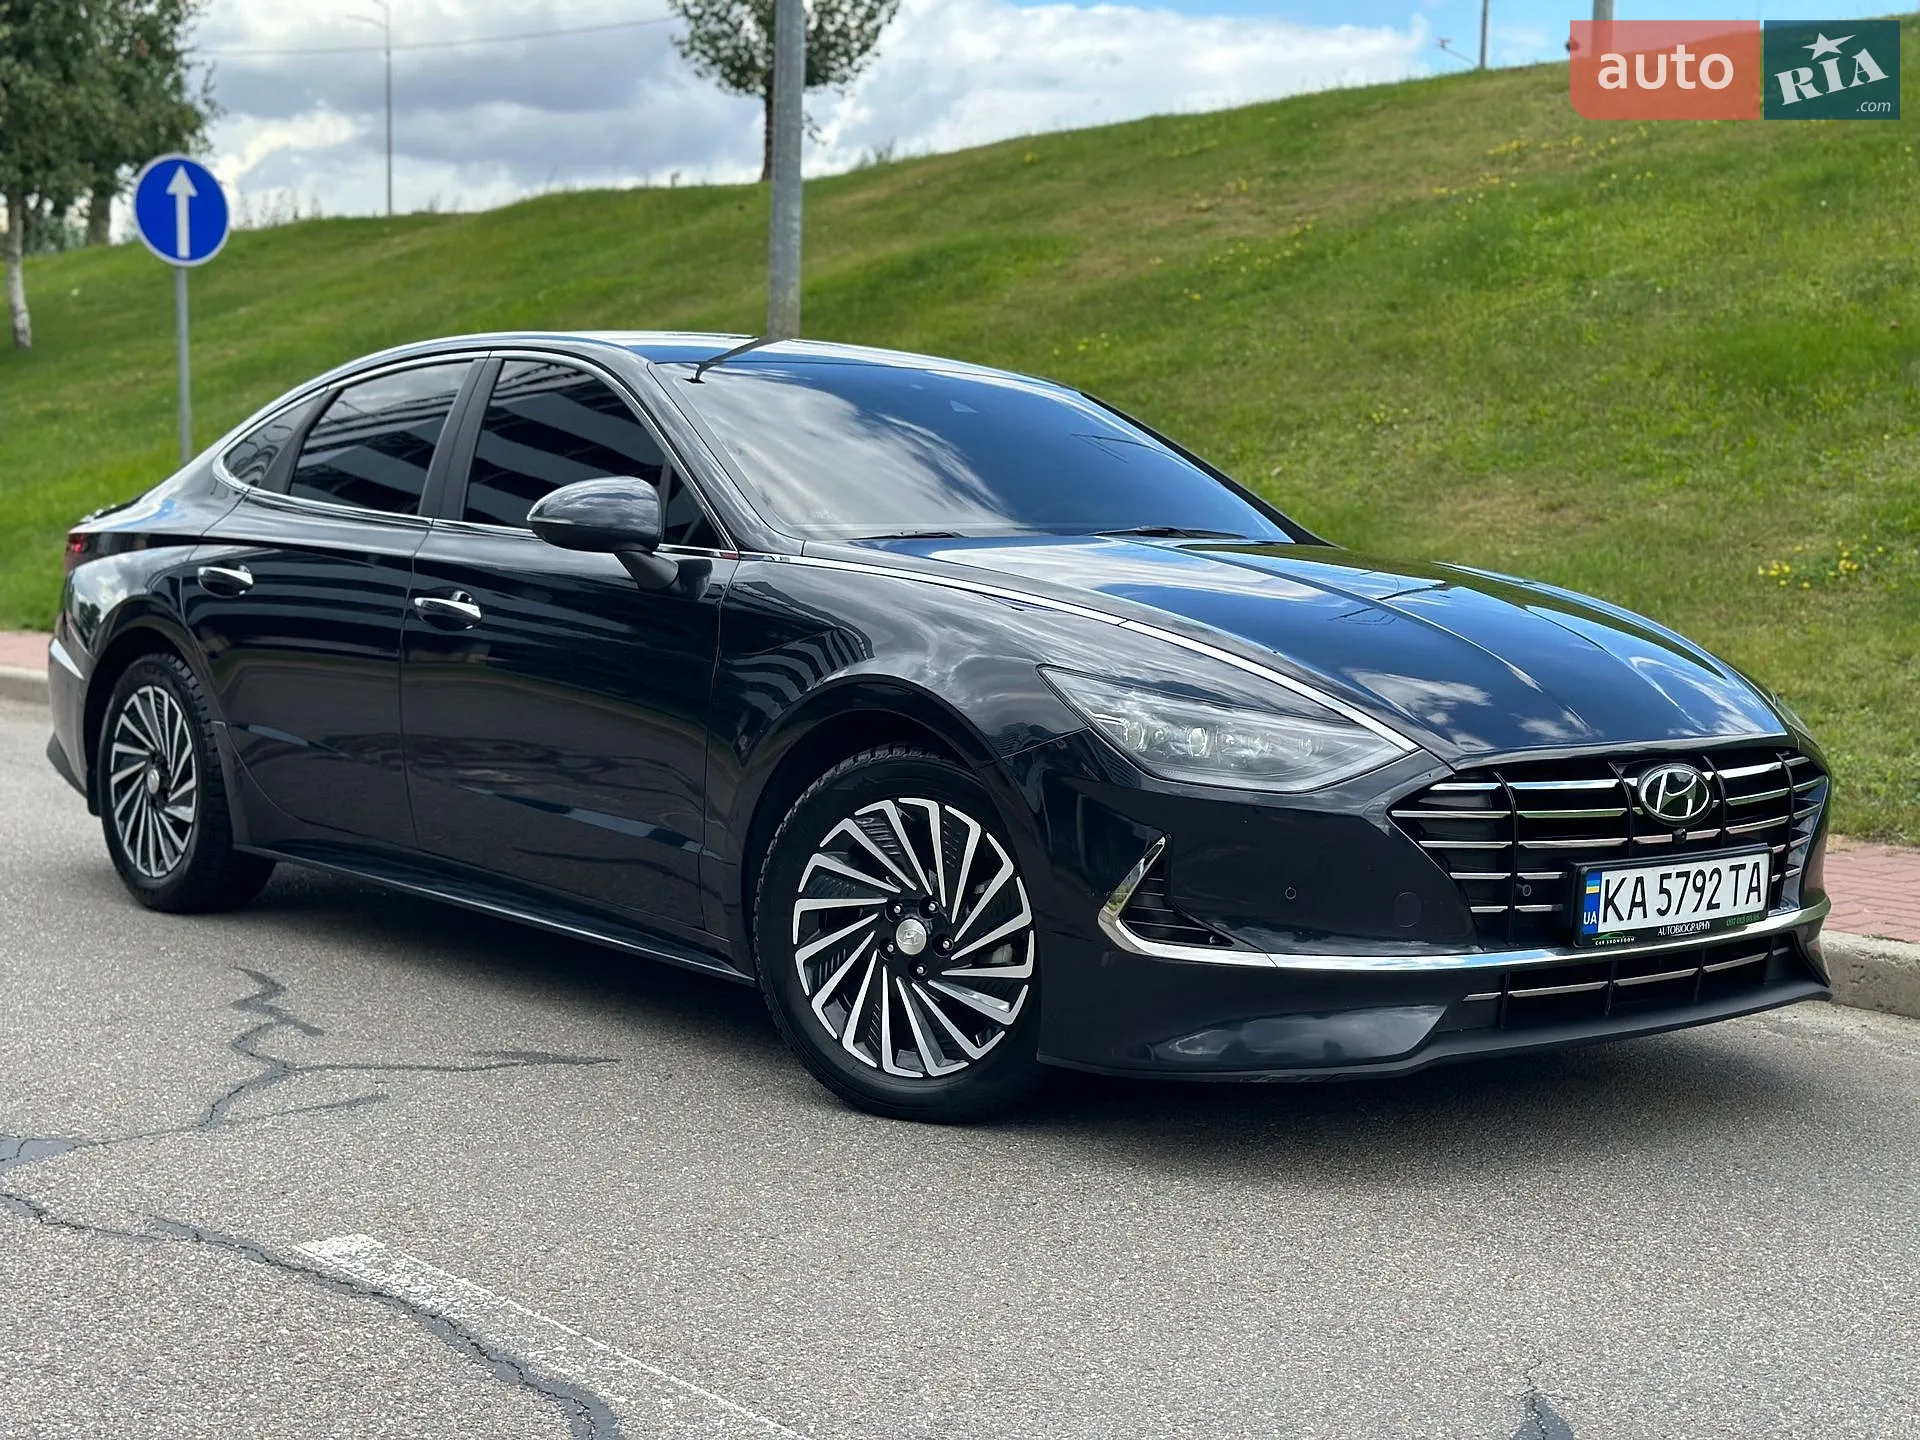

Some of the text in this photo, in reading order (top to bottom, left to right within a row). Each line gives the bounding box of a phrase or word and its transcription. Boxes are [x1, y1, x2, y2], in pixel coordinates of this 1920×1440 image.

[1602, 861, 1762, 923] KA 5792 TA
[1583, 911, 1597, 925] UA
